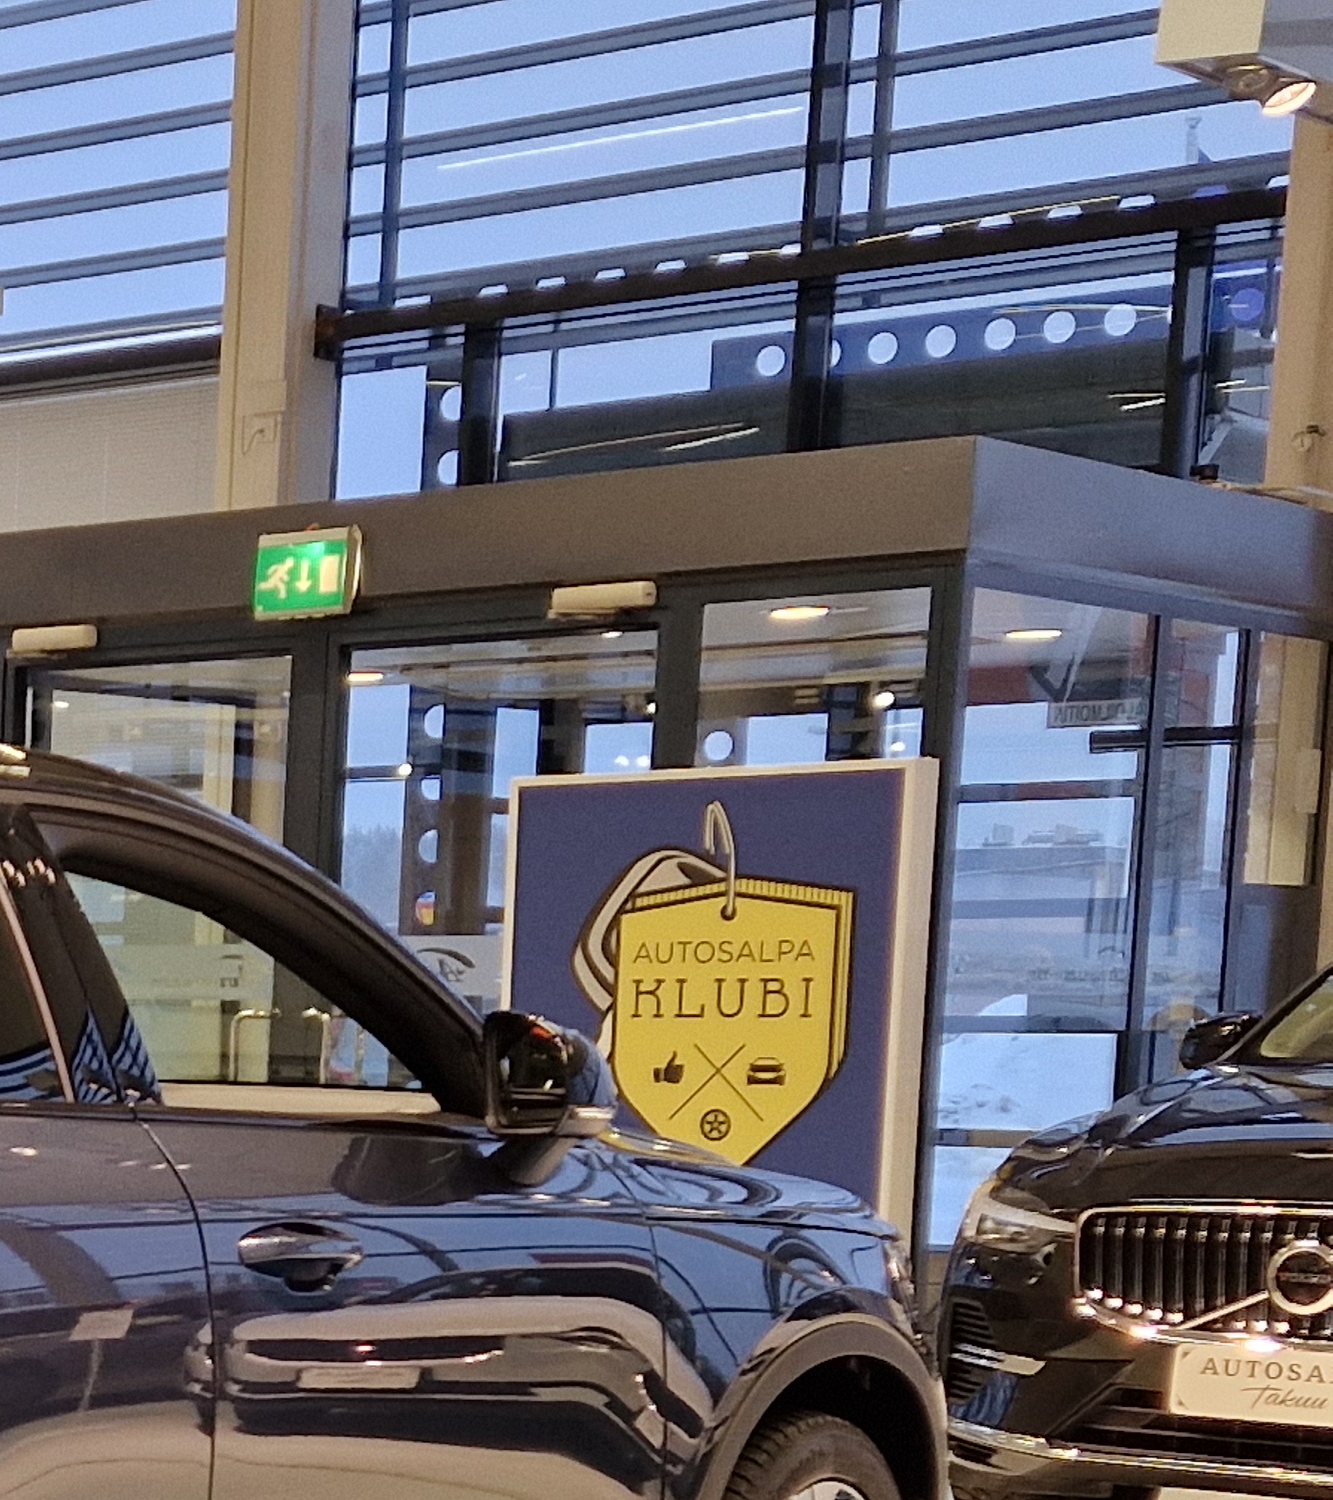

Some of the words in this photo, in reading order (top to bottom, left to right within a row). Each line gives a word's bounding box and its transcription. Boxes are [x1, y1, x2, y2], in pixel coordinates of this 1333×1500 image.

[633, 939, 815, 964] AUTOSALPA
[631, 977, 814, 1018] KLUBI
[1199, 1357, 1333, 1385] AUTOSA
[1241, 1384, 1329, 1410] Takuu
